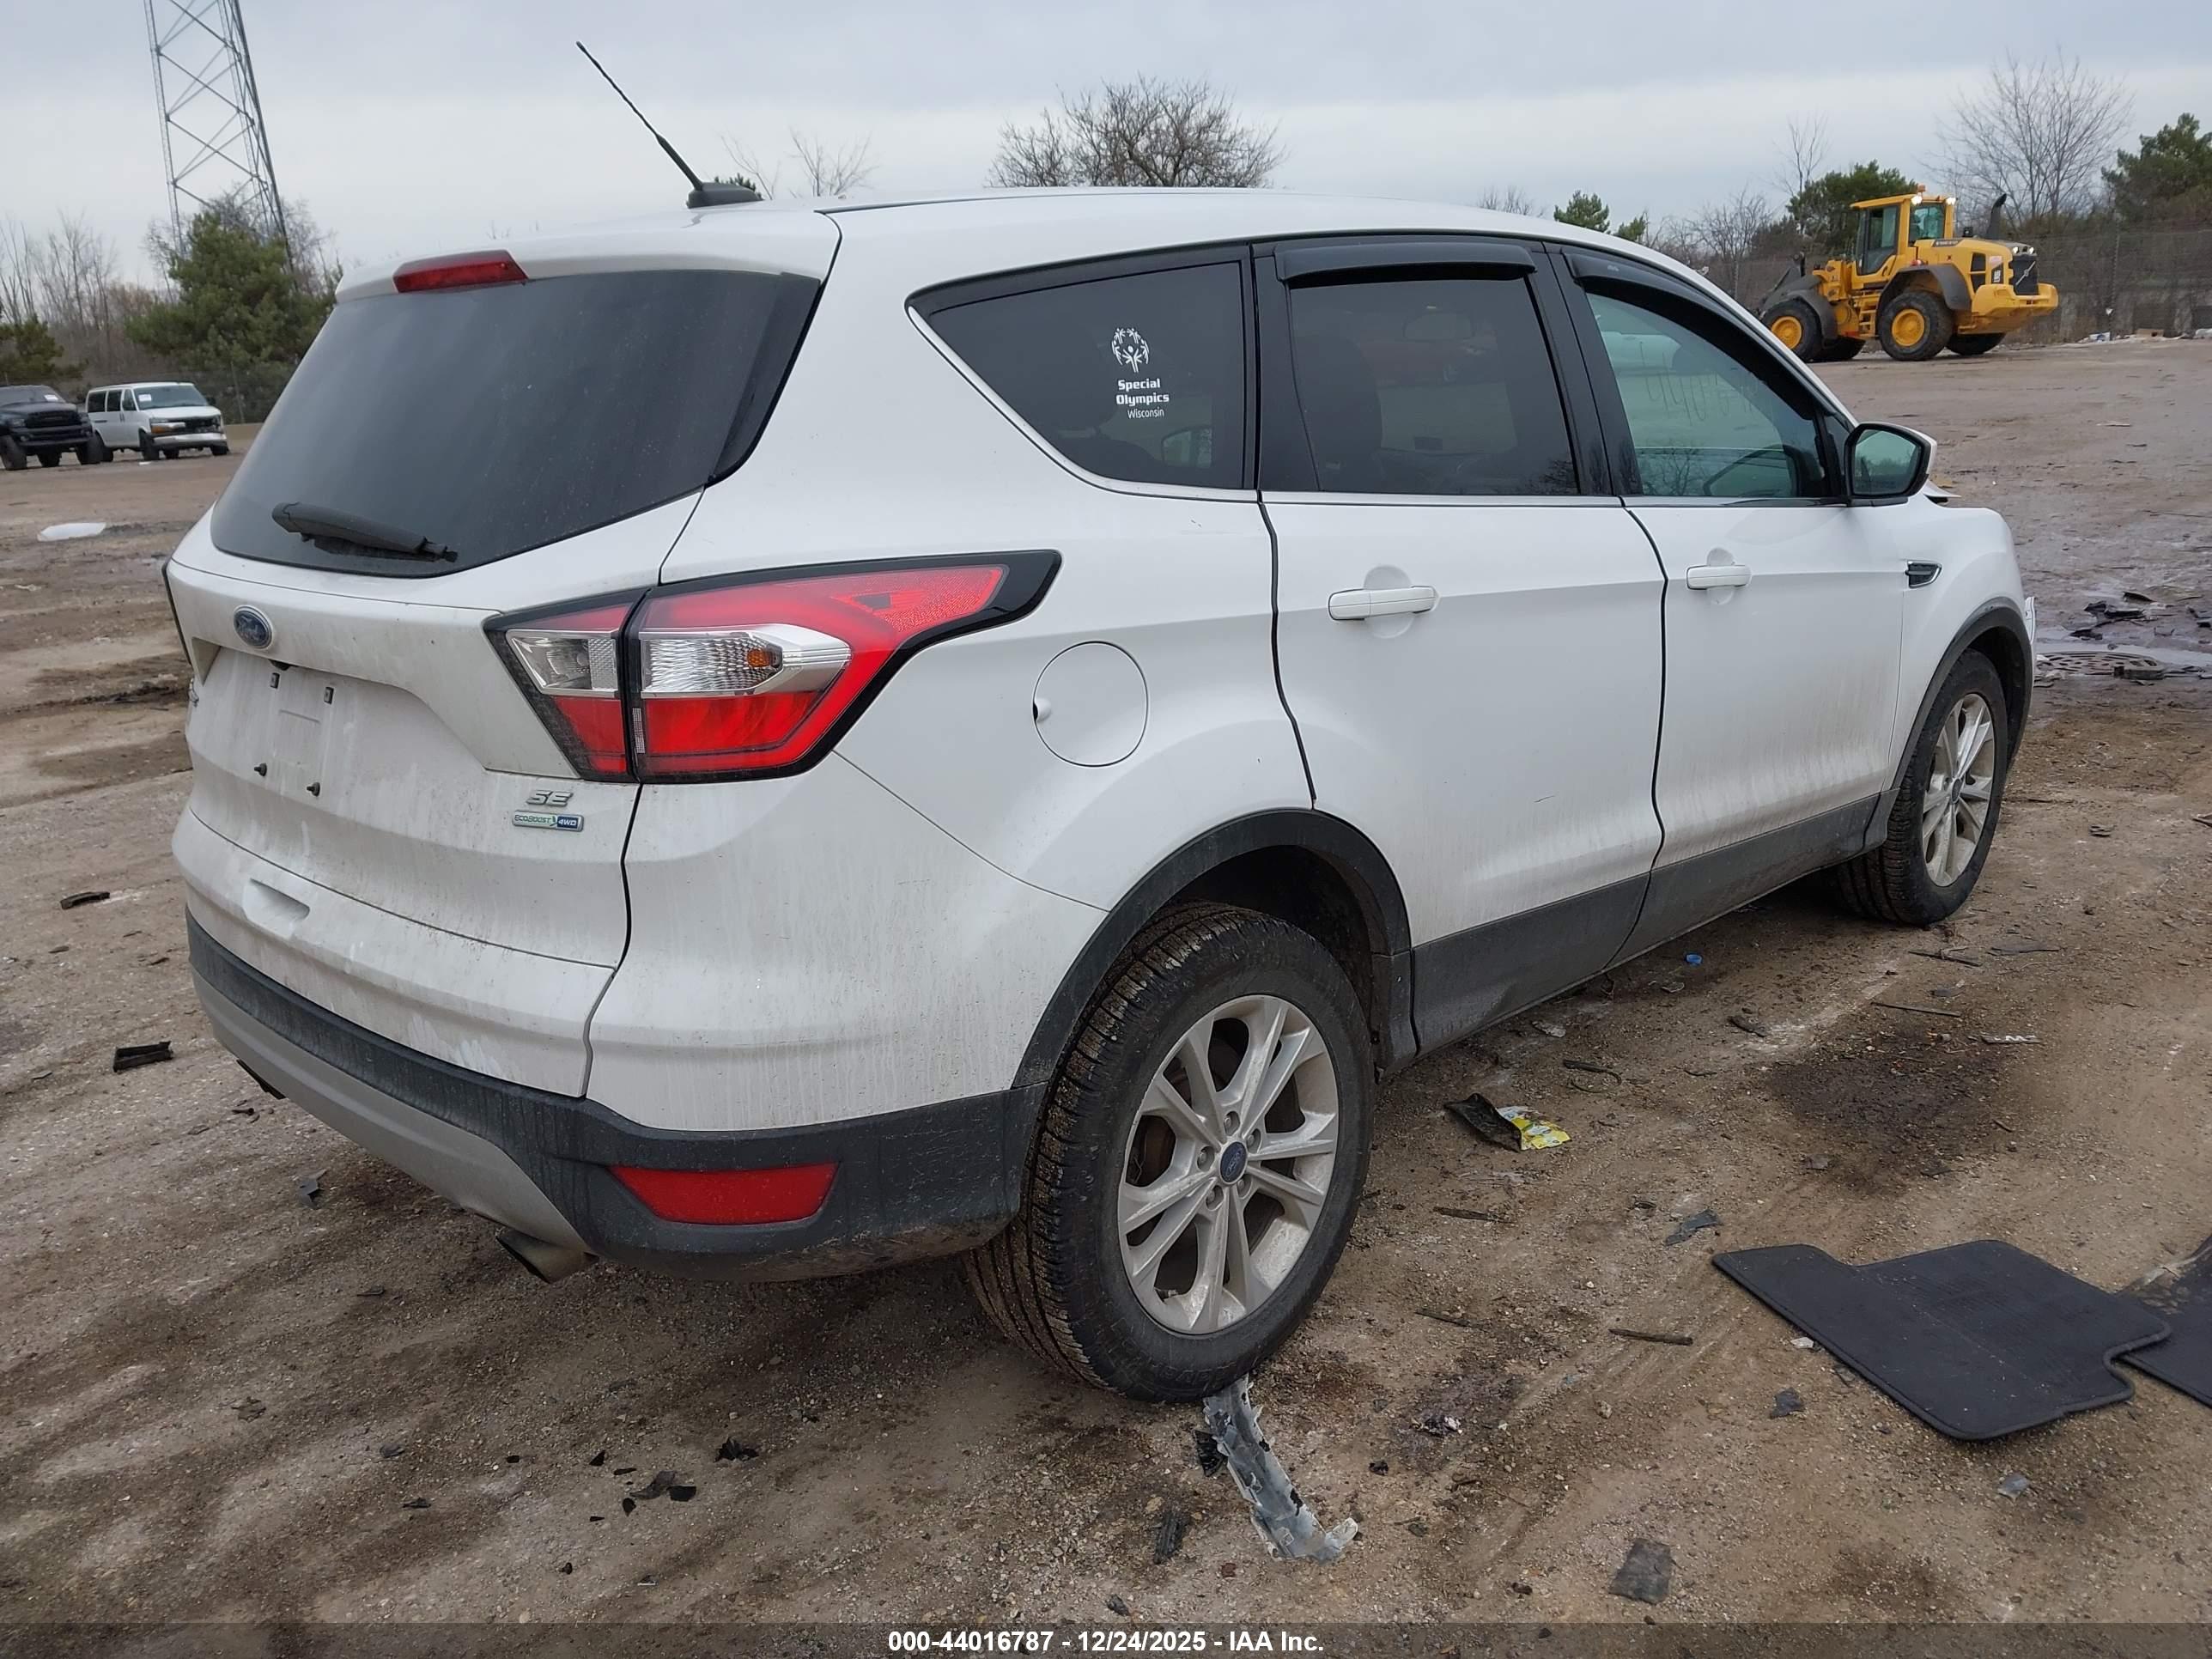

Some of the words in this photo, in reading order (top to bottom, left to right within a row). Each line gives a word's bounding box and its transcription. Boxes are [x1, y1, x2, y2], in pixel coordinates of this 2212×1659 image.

[1118, 378, 1161, 392] Special
[1116, 392, 1170, 407] Olympics
[1127, 406, 1165, 420] Wisconsin
[526, 789, 574, 807] SE
